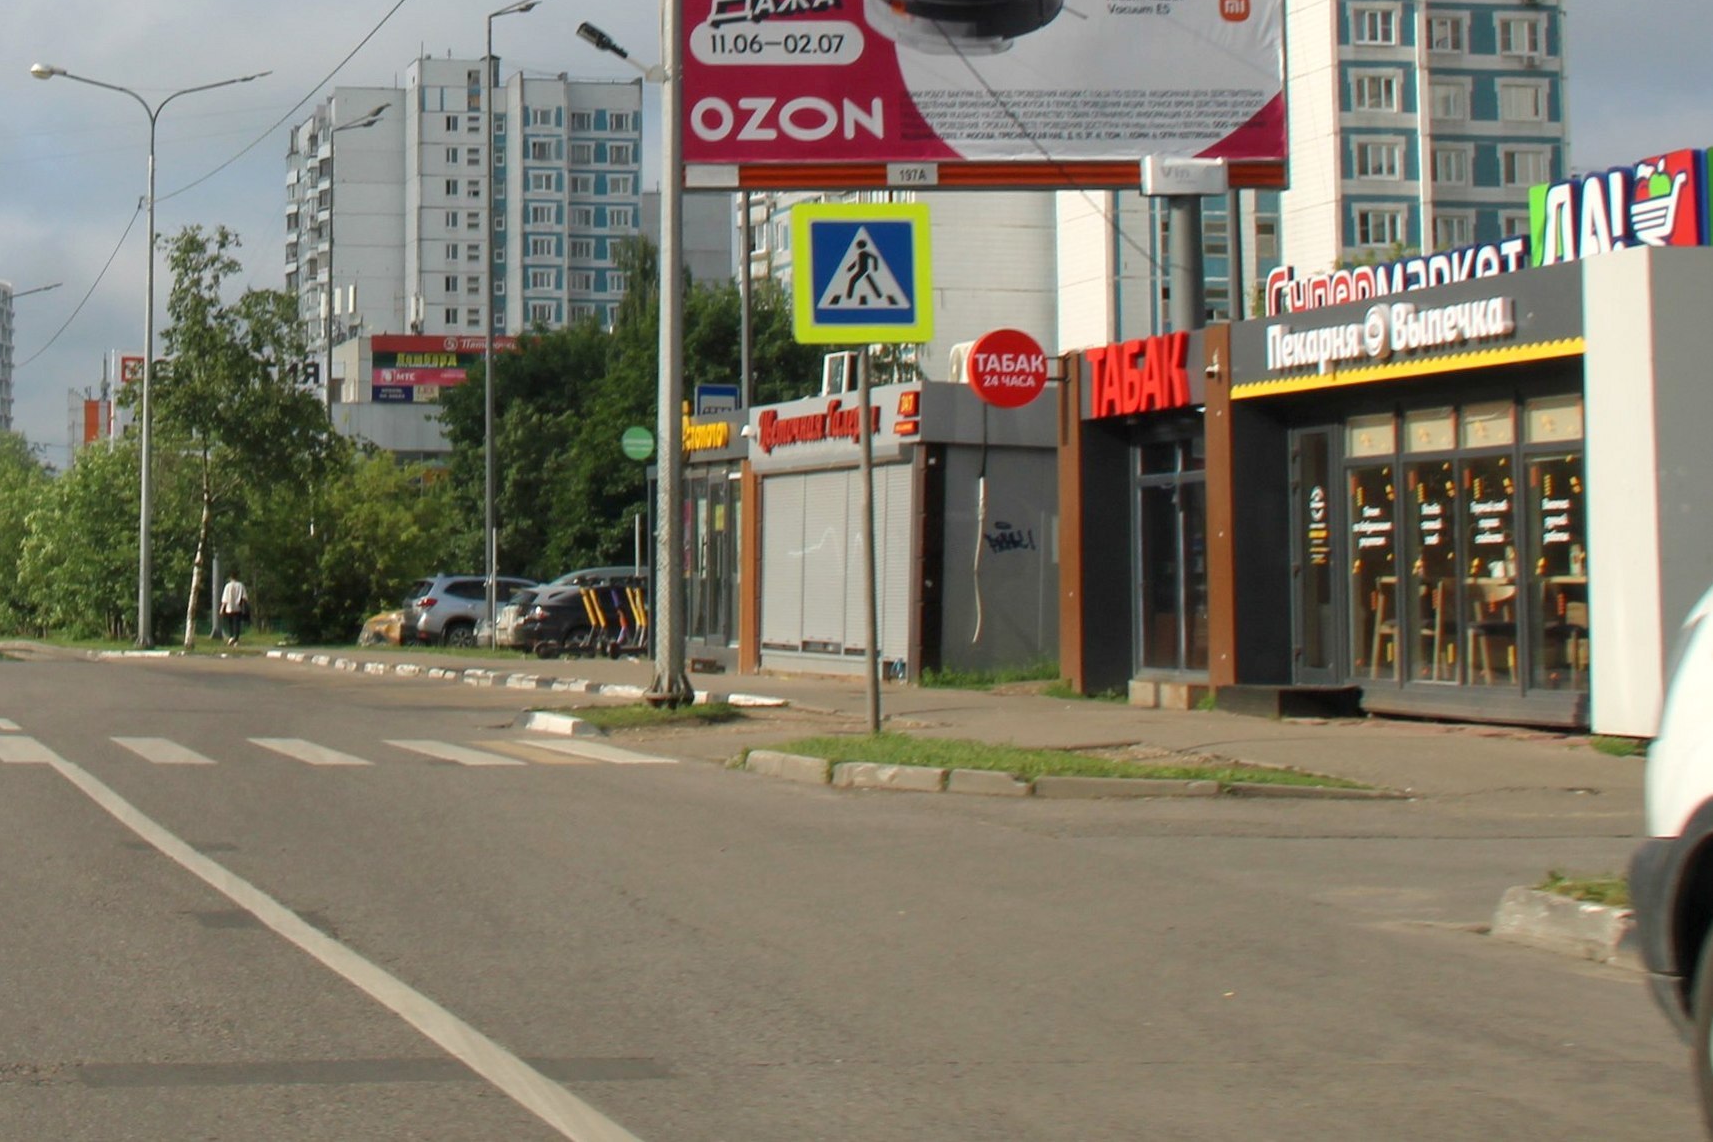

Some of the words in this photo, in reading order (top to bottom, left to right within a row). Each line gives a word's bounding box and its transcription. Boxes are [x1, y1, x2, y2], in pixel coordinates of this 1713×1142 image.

[690, 96, 885, 142] OZON
[1267, 323, 1363, 375] Пекарня
[1390, 296, 1512, 351] Выпечка
[974, 352, 1045, 374] ТАБАК
[983, 374, 999, 387] 24
[1001, 374, 1036, 388] ЧАСА
[1085, 331, 1191, 419] ТАБАК
